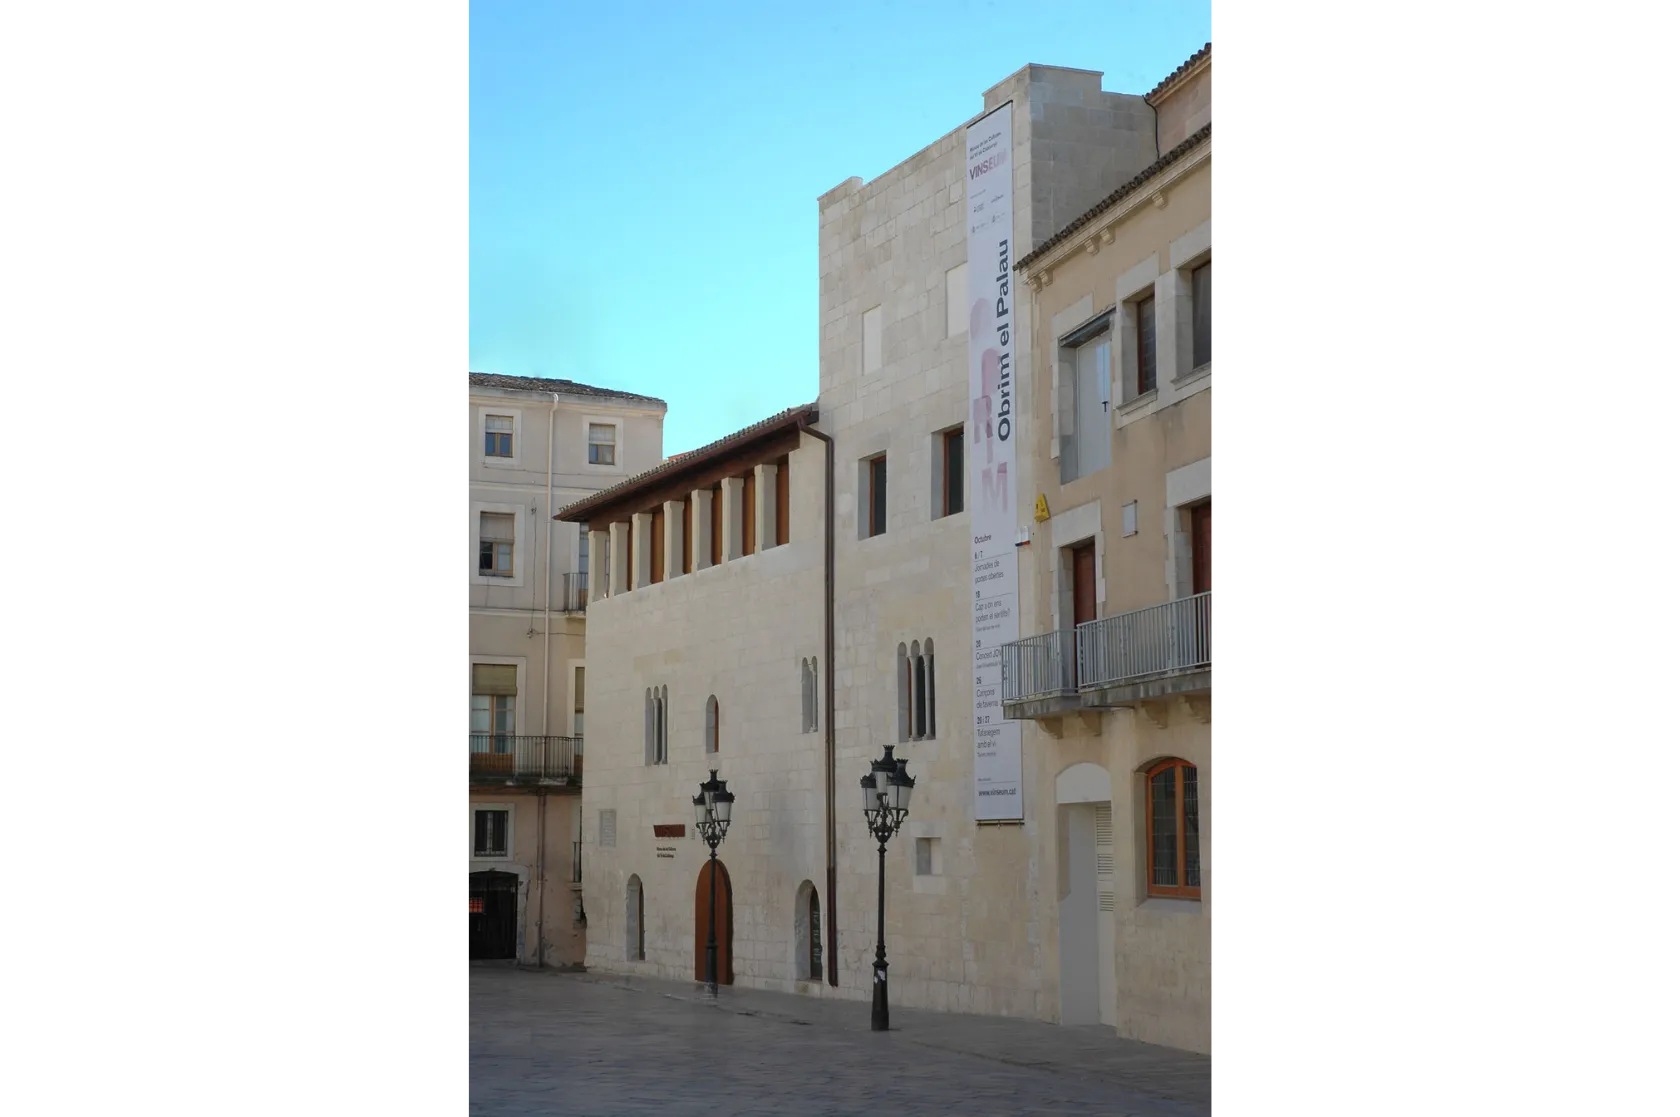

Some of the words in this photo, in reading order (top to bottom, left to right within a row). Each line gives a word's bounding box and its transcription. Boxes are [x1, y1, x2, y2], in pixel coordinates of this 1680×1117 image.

[969, 148, 1007, 181] VINSEUM
[996, 239, 1010, 316] Palau
[996, 322, 1010, 347] el
[997, 352, 1011, 442] Obrim
[974, 533, 992, 544] Octubre
[974, 562, 994, 573] Jornades
[994, 559, 1000, 568] de
[975, 650, 992, 661] Concert
[978, 787, 1017, 797] www.vinseum.cat
